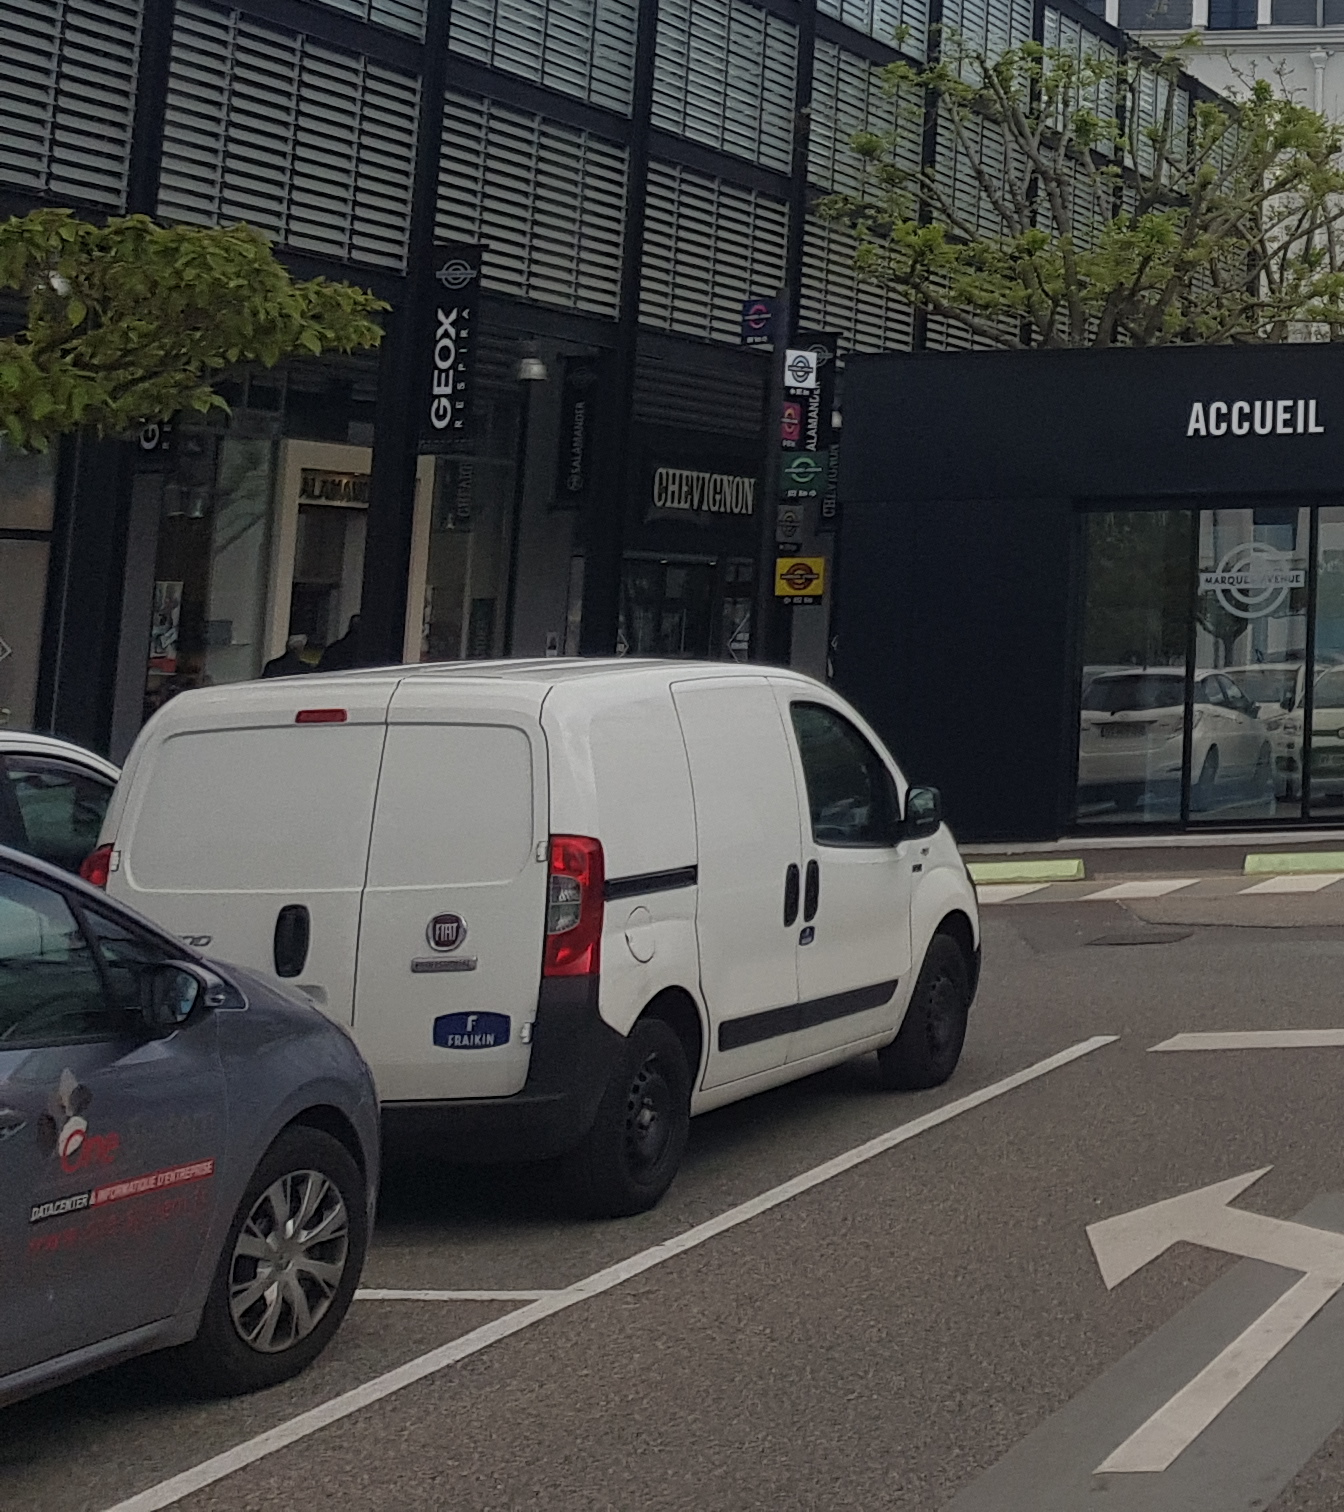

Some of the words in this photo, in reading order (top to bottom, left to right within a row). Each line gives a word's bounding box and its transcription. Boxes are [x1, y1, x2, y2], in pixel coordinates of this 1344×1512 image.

[431, 307, 458, 429] GEOX
[454, 308, 470, 428] RESPIRA
[1187, 399, 1325, 437] ACCUEIL
[654, 467, 756, 515] CHEVIGNON
[435, 922, 459, 942] FIAT
[448, 1033, 495, 1047] FRAIKIN
[30, 1194, 89, 1222] DATACENTER
